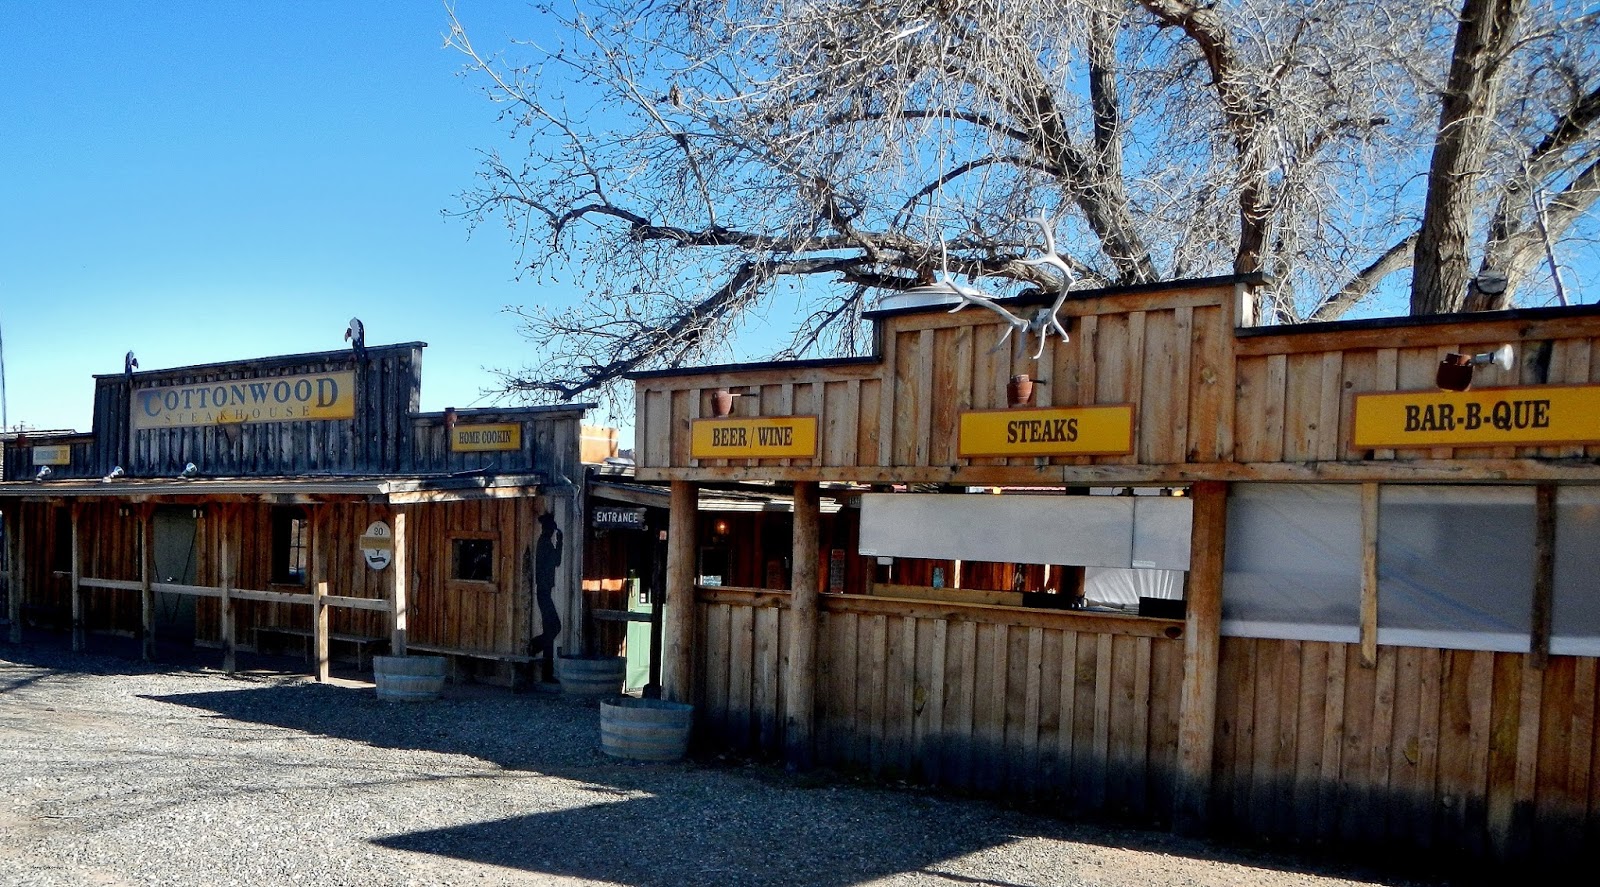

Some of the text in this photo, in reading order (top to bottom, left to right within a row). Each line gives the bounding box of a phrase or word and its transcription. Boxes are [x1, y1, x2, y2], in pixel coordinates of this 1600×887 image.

[143, 377, 339, 417] COTTONWOOD
[164, 405, 310, 424] STEAKHOUSE
[1404, 399, 1550, 432] BAR-B-QUE
[459, 430, 512, 444] HOME COOKIN
[1007, 418, 1078, 444] STEAKS
[596, 511, 639, 523] ENTRANCE
